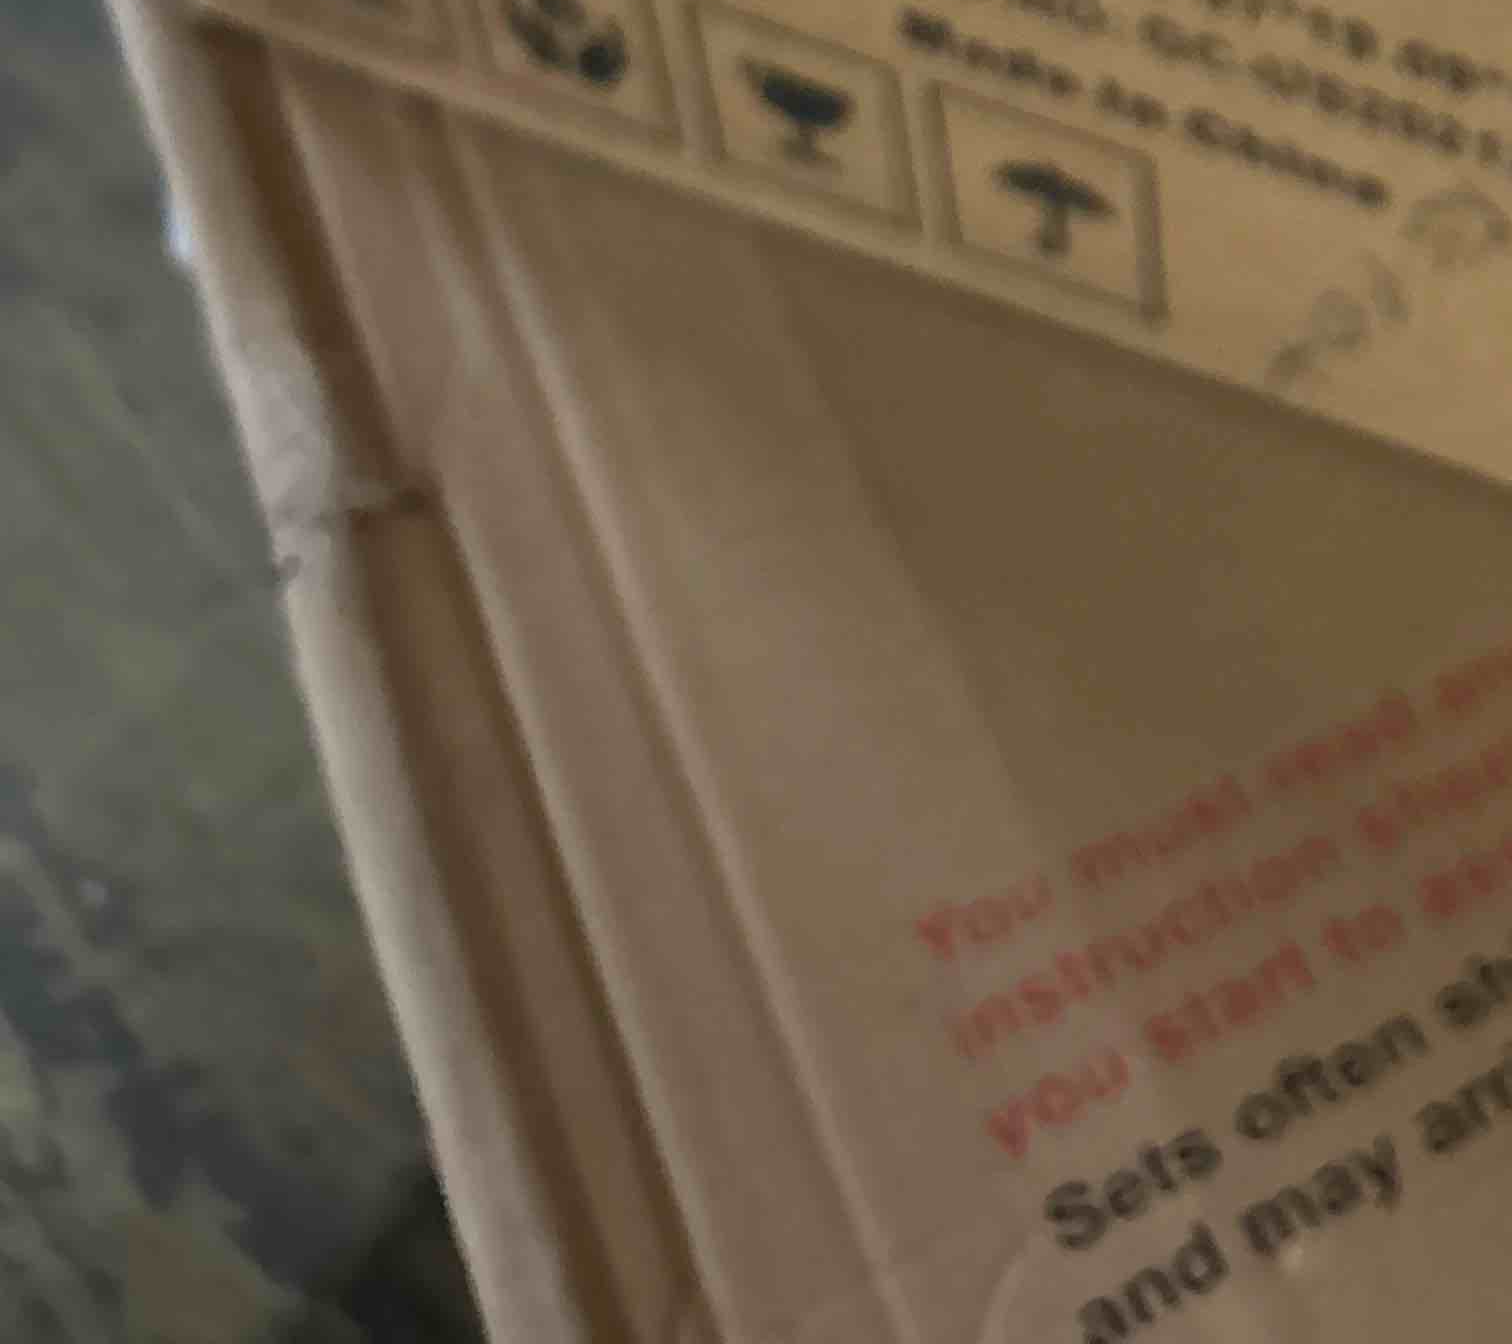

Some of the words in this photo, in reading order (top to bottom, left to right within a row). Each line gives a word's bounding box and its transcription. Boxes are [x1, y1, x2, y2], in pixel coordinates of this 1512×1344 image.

[918, 873, 1053, 961] You
[985, 1048, 1130, 1162] you
[1144, 937, 1317, 1065] start
[1323, 903, 1407, 965] to
[1044, 1126, 1222, 1252] Sets
[1235, 1012, 1429, 1141] often
[1077, 1220, 1229, 1344] and
[1239, 1132, 1401, 1260] may
